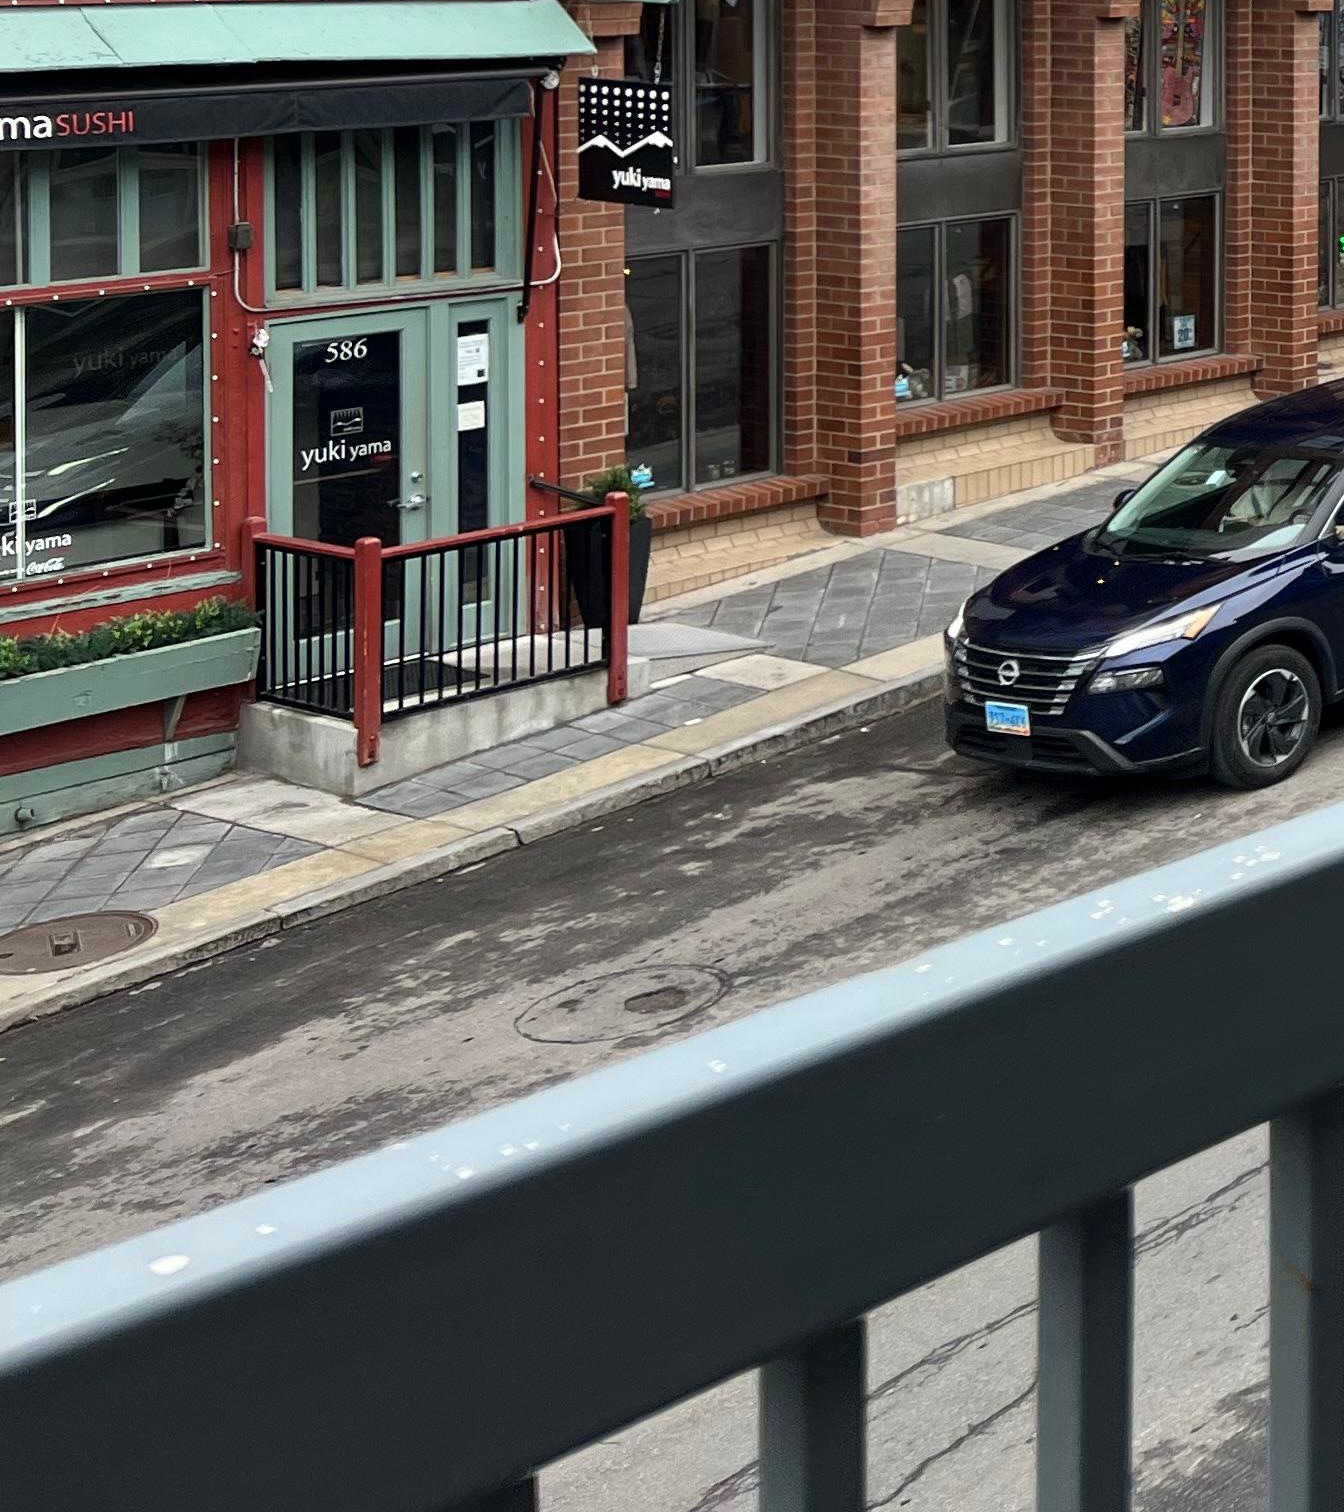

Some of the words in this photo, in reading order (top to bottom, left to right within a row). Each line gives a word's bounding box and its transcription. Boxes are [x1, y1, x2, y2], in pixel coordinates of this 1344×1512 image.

[56, 111, 135, 136] SUSHI
[611, 167, 642, 190] yuki
[641, 178, 671, 192] yama
[325, 337, 369, 364] 586
[301, 439, 346, 471] yuki
[349, 440, 392, 462] yama
[25, 533, 72, 557] yama
